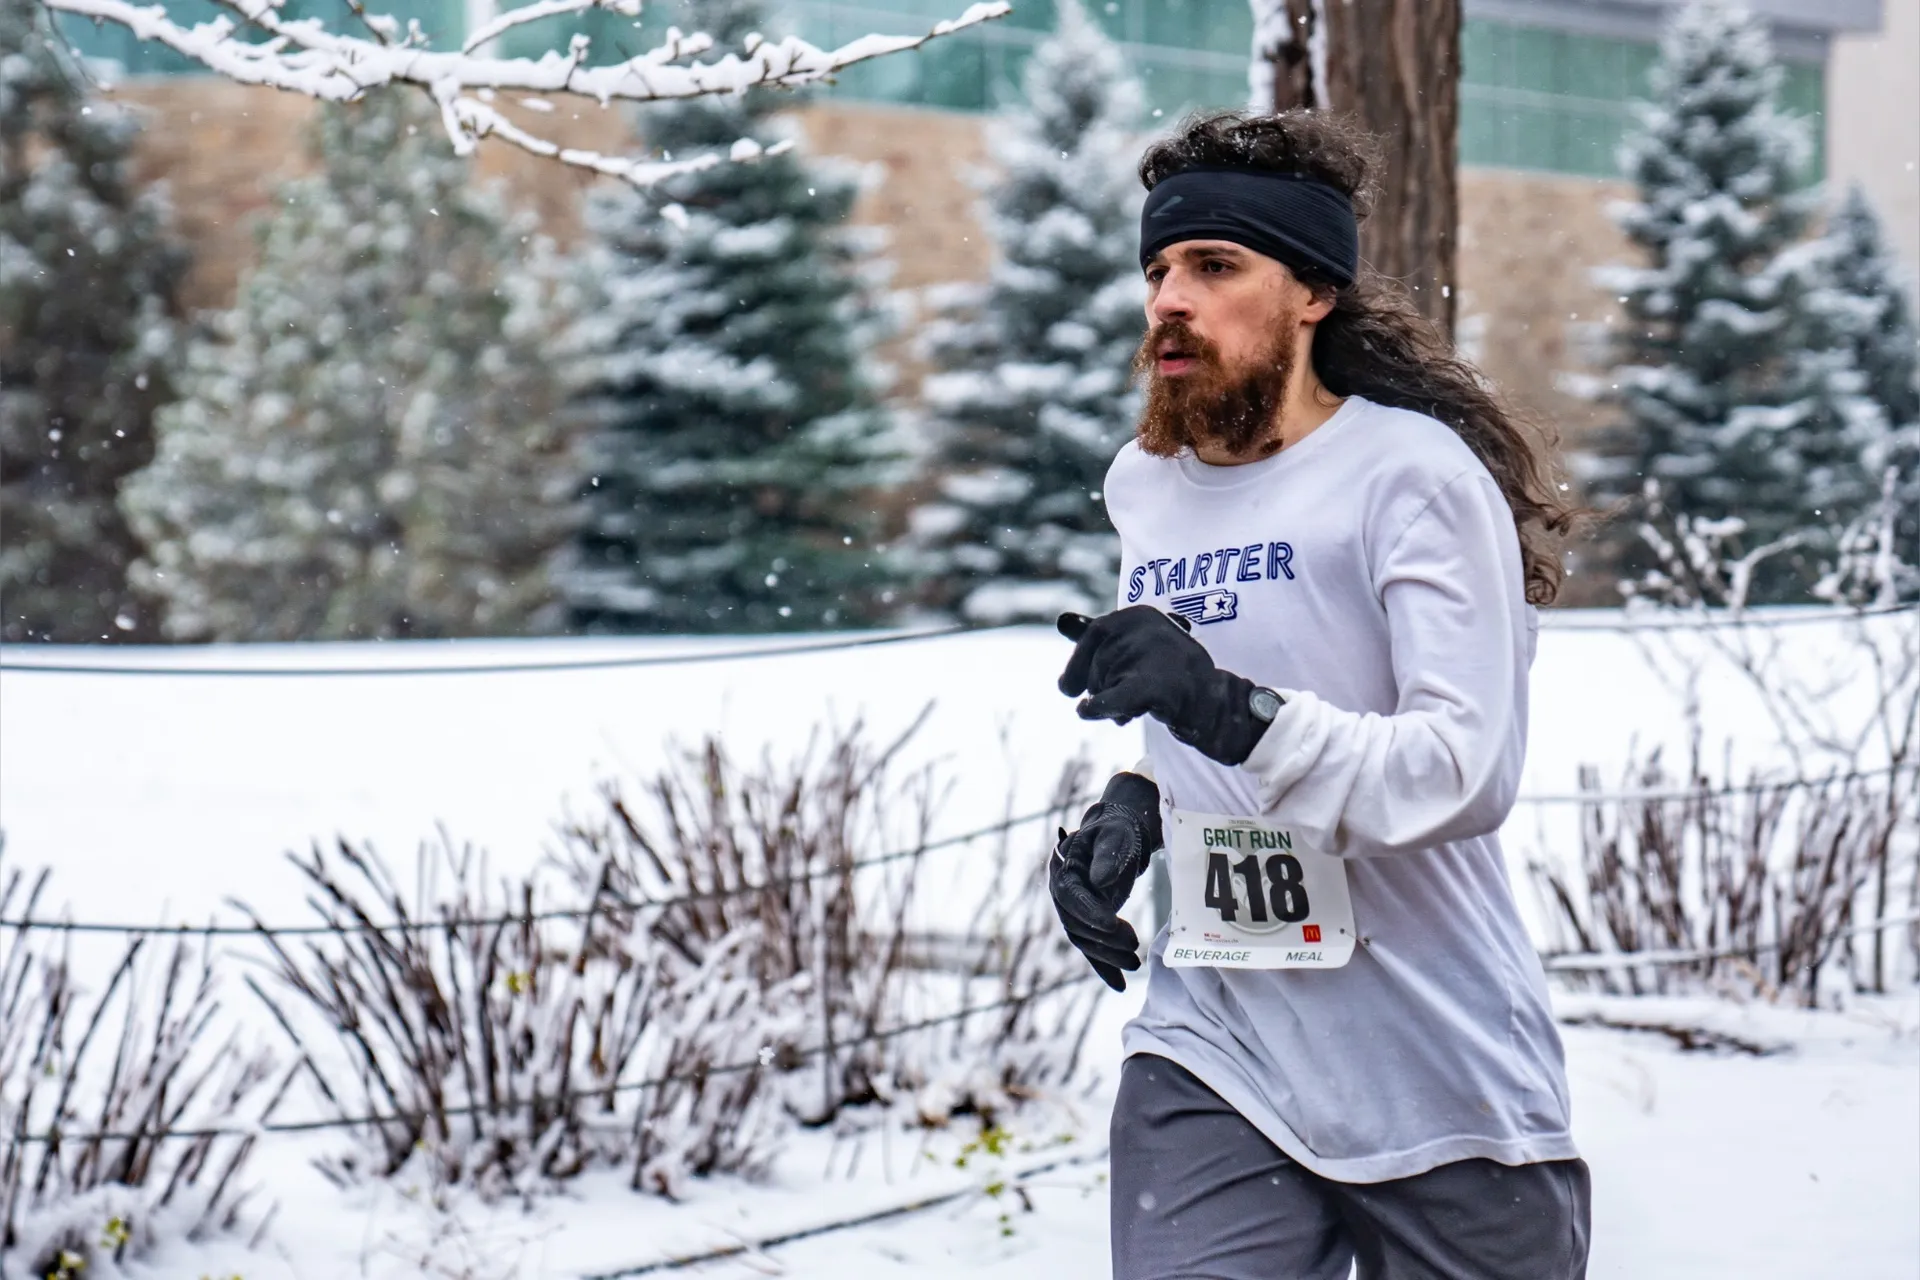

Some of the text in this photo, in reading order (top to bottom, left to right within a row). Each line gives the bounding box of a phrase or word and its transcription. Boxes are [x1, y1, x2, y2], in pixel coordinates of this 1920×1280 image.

[1128, 542, 1295, 603] STARTER
[1203, 827, 1293, 850] GRIT RUN
[1204, 852, 1310, 923] 418
[1173, 948, 1324, 962] BEVERAGE MEAL
